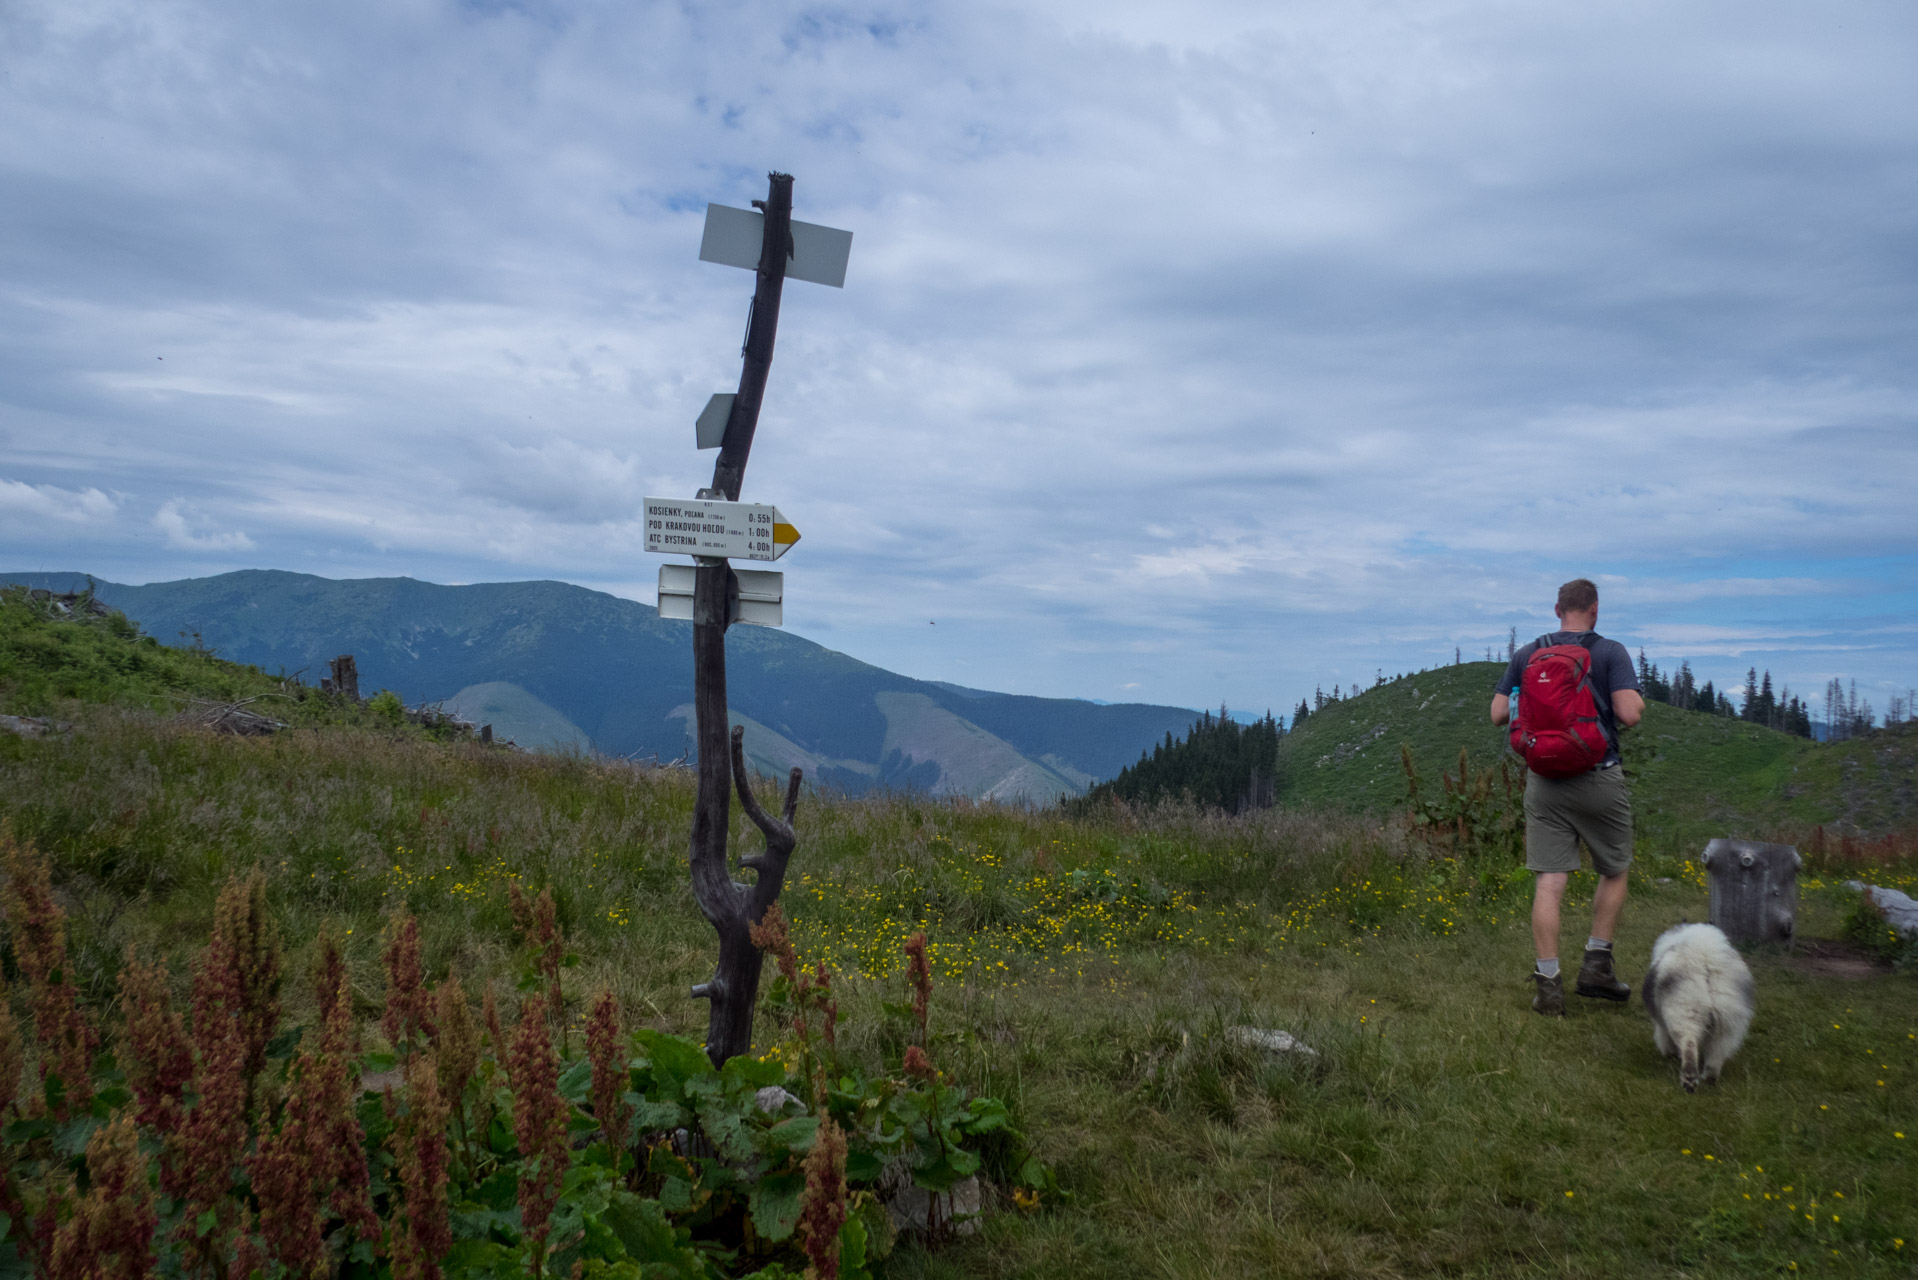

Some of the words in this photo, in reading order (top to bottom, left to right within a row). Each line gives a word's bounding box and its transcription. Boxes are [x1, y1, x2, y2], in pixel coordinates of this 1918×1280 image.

[649, 506, 683, 518] KOSIENKY,
[649, 520, 662, 530] POD
[665, 521, 701, 533] KRAKOVOU
[649, 533, 662, 543] ATC
[665, 534, 697, 546] BYSTRINA
